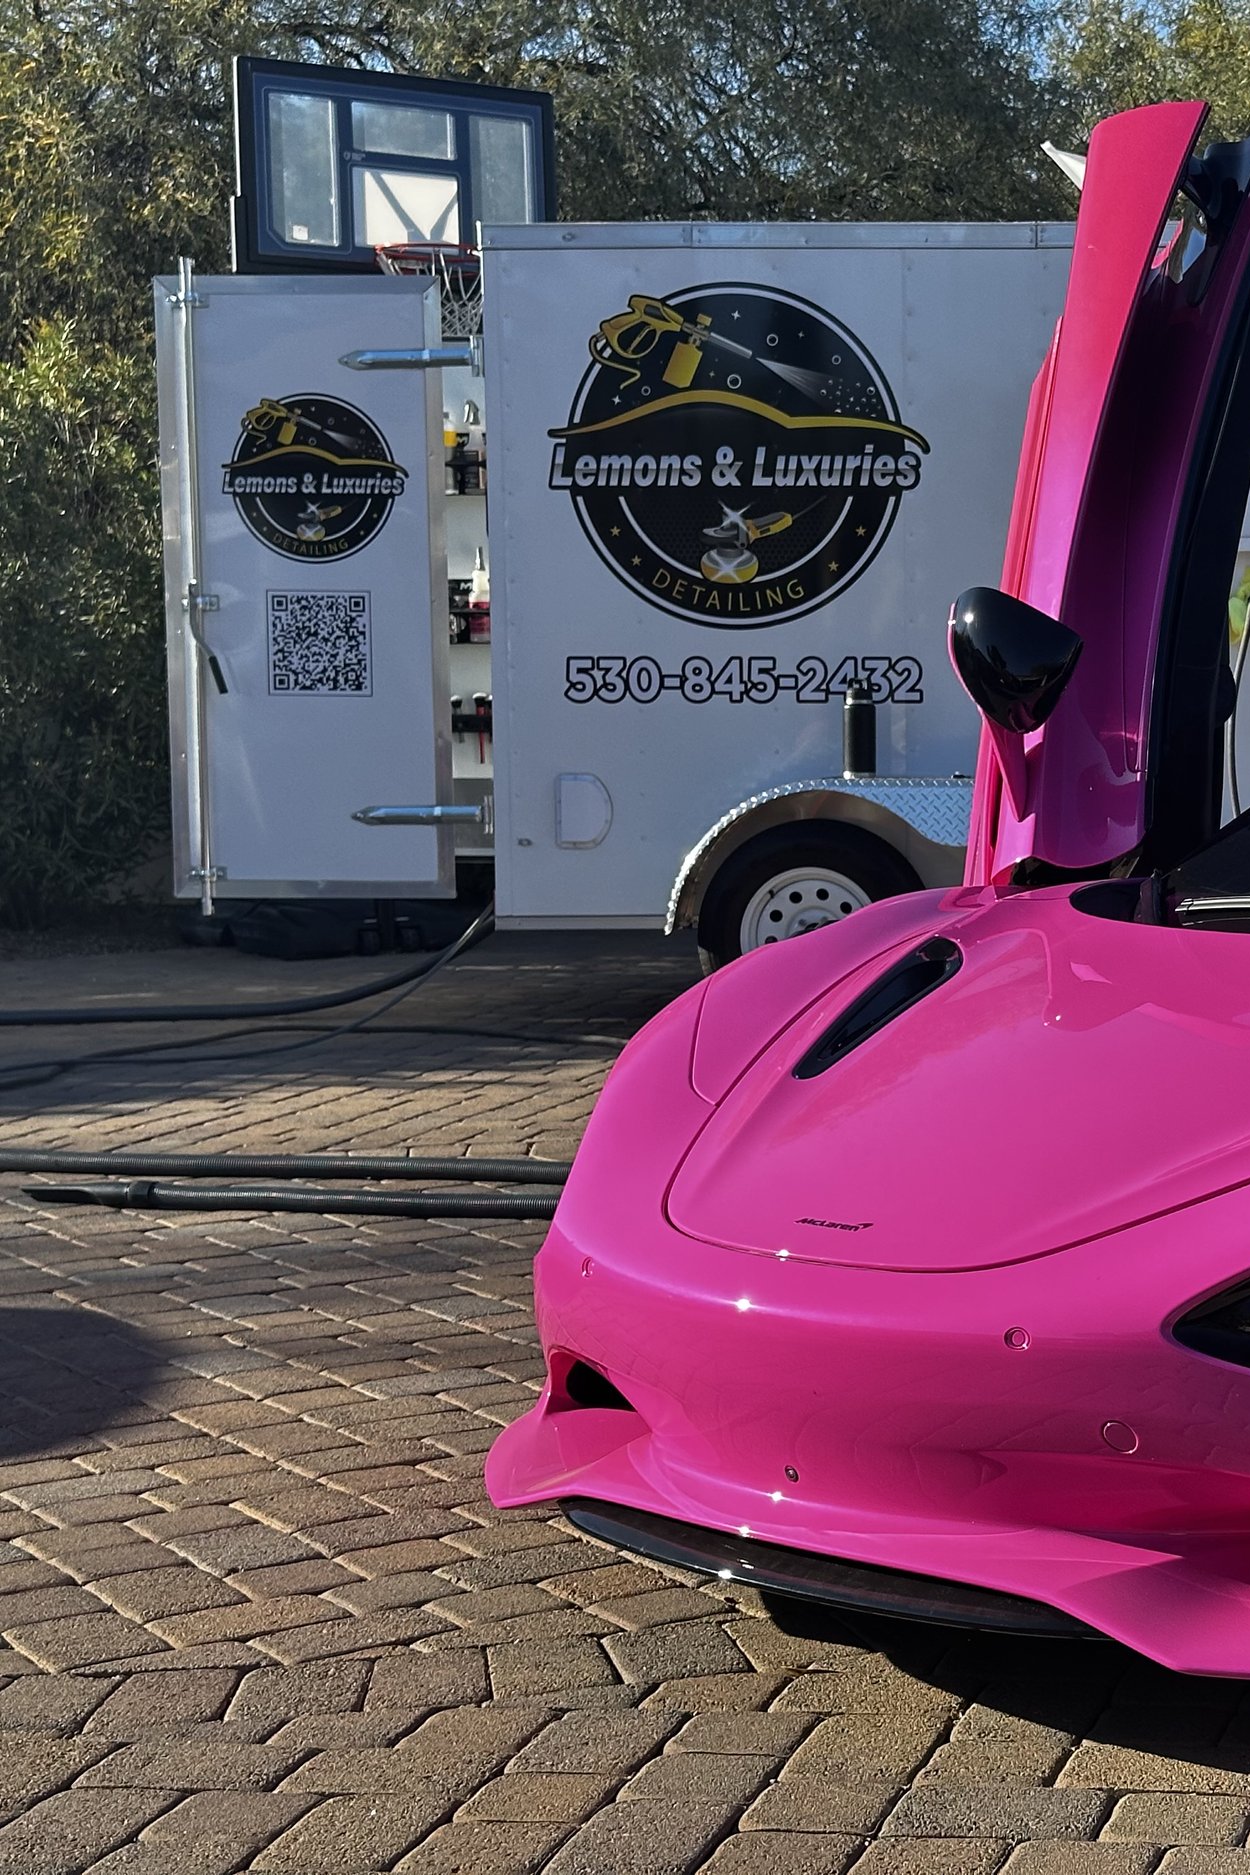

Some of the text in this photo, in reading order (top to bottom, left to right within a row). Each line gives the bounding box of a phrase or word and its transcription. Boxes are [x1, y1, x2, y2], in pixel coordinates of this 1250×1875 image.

[223, 471, 404, 495] Lemons & Luxuries
[551, 443, 921, 489] Lemons & Luxuries
[272, 533, 349, 556] DETAILING
[651, 568, 806, 612] DETAILING
[565, 656, 924, 704] 530-845-2432
[794, 1217, 861, 1232] McLaren
